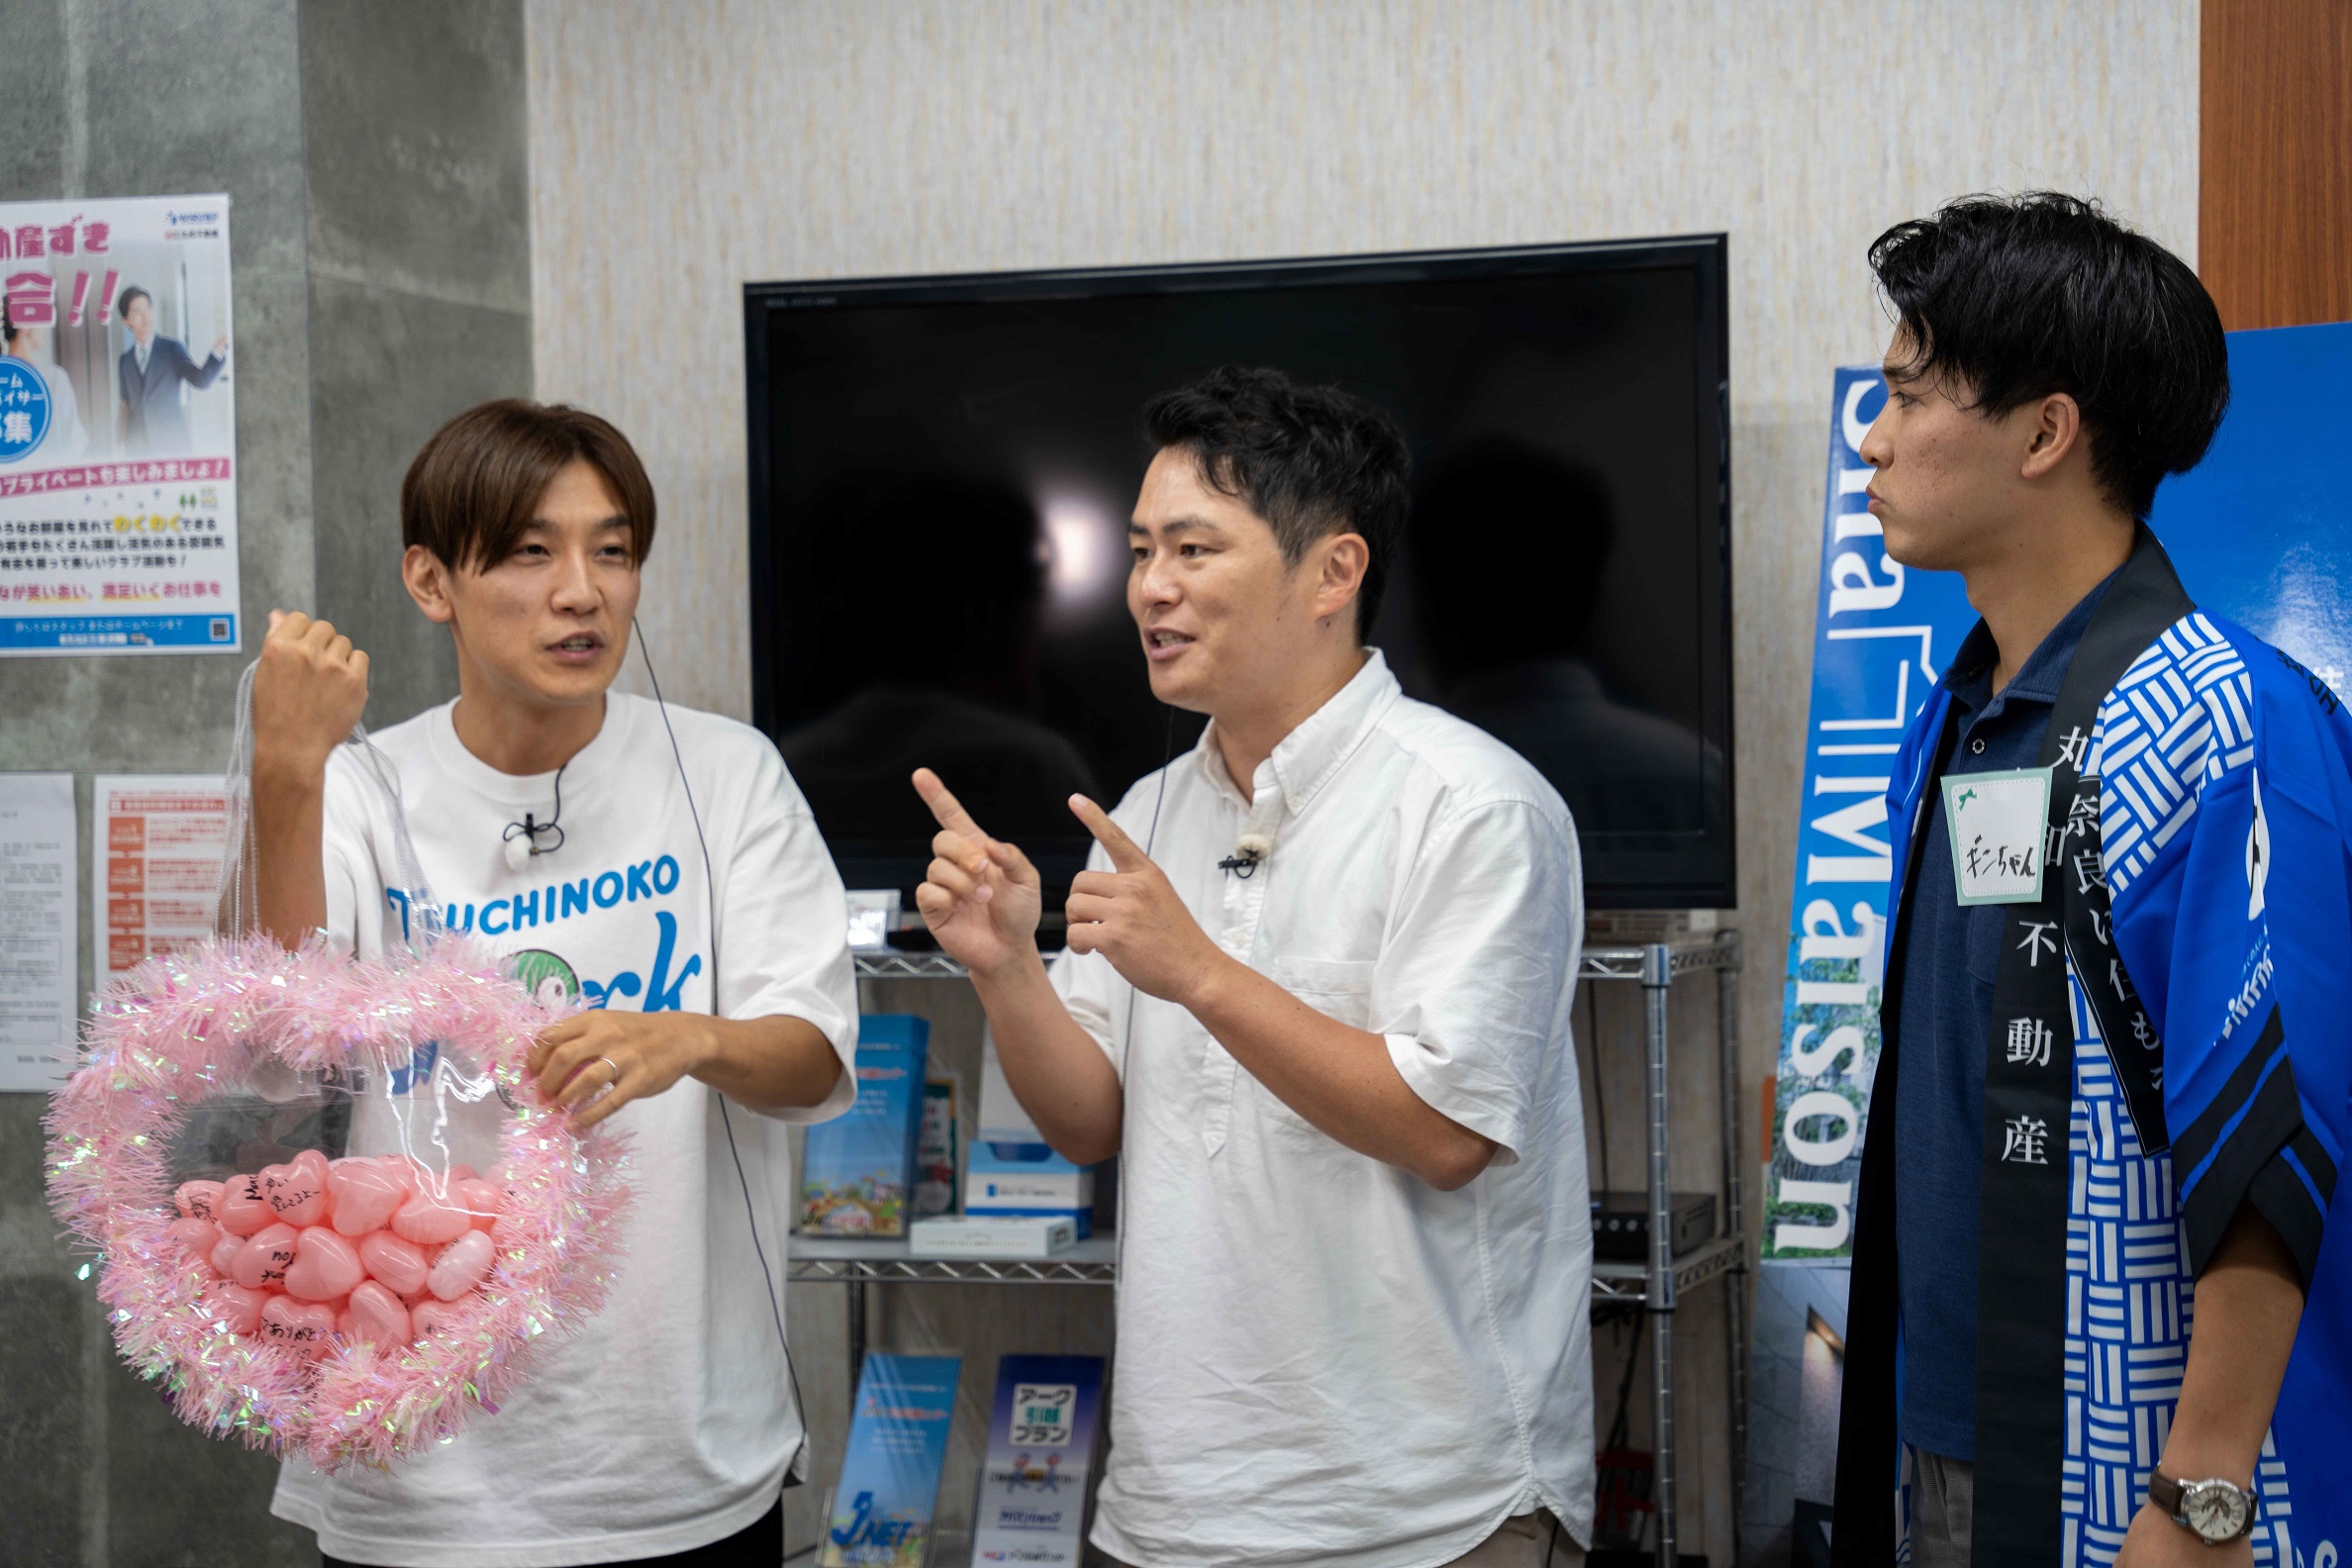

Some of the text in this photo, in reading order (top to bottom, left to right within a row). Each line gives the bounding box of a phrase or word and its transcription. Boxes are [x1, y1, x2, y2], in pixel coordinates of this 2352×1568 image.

[0, 389, 44, 406] イサー
[0, 410, 33, 444] 集
[0, 458, 224, 496] プライベートも楽しみましょ!
[1773, 774, 1892, 1252] Maison
